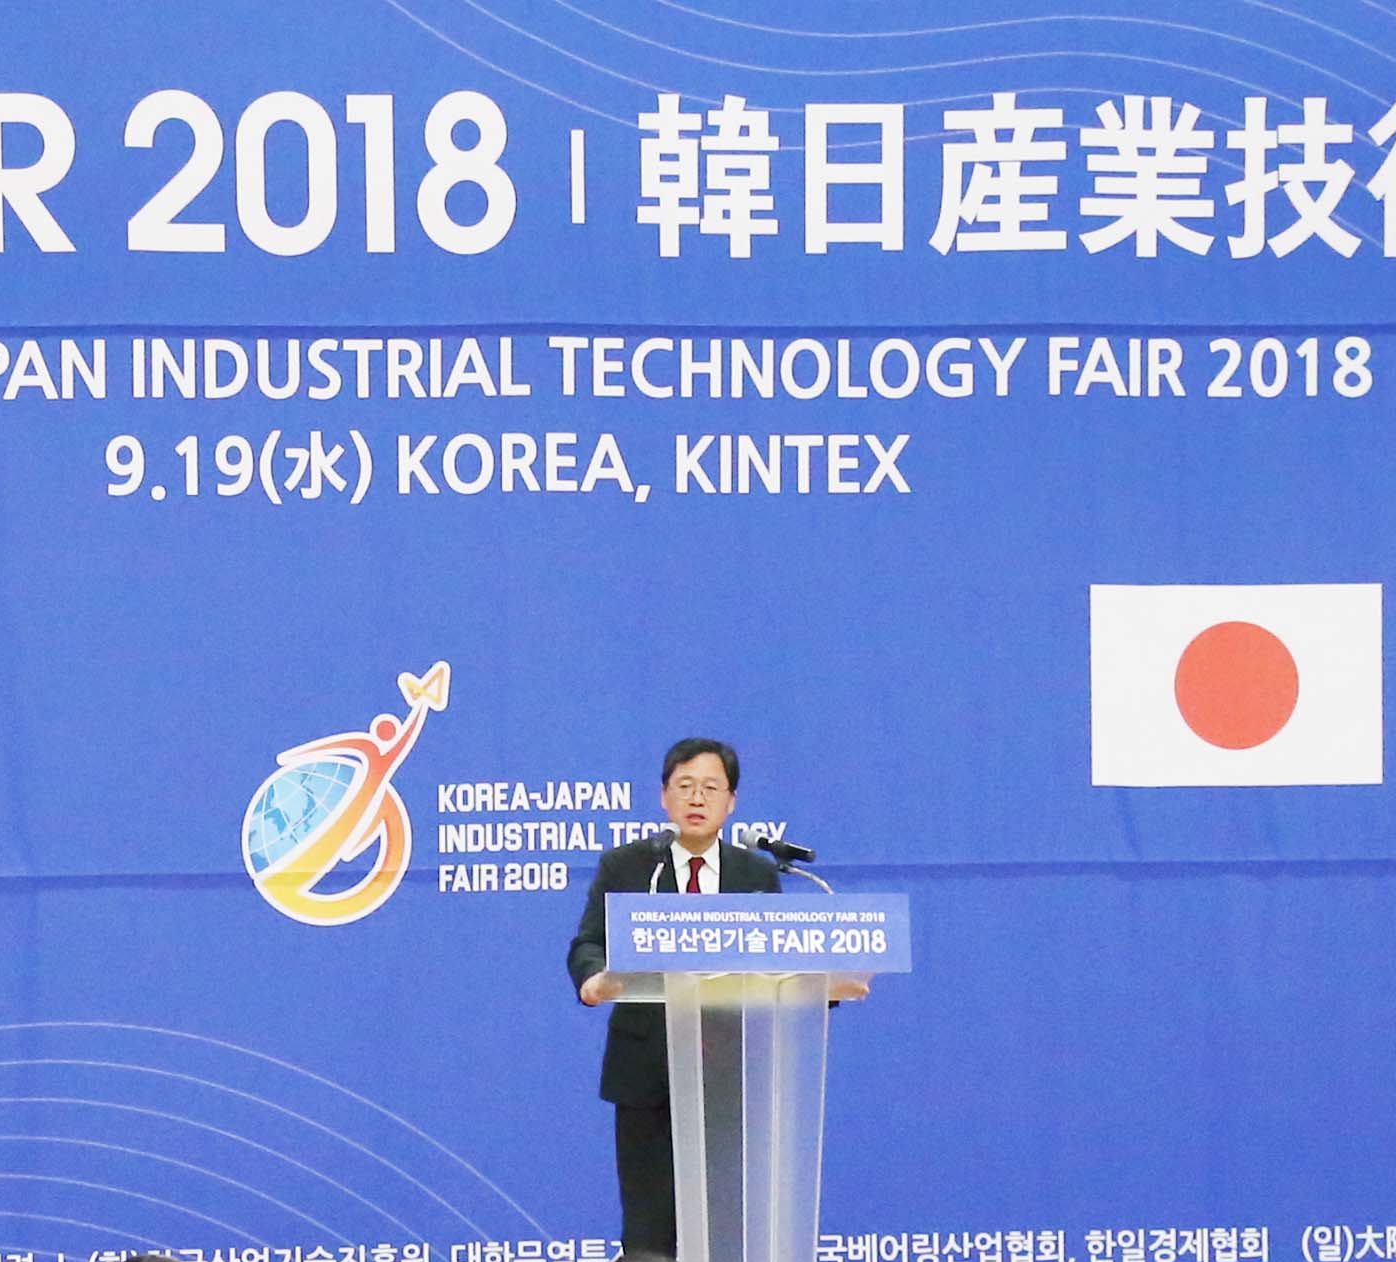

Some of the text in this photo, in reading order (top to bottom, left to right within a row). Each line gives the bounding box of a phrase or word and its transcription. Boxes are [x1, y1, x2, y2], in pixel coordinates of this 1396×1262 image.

[123, 88, 517, 257] 2018
[131, 335, 532, 401] INDUSTRIAL
[548, 335, 1028, 400] TECHNOLOGY
[1048, 335, 1187, 398] FAIR
[1206, 335, 1374, 399] 2018
[104, 429, 912, 506] 9.19(水) KOREA, KINTEX
[437, 780, 632, 814] KOREA-JAPAN
[437, 820, 605, 854] INDUSTRIAL
[438, 861, 569, 893] FAIR 2018
[631, 911, 886, 923] KOREA-JAPAN INDUSTRIAL TECHNOLOGY FAIR 2018
[631, 927, 887, 954] 한일산업기술 FAIR 2018
